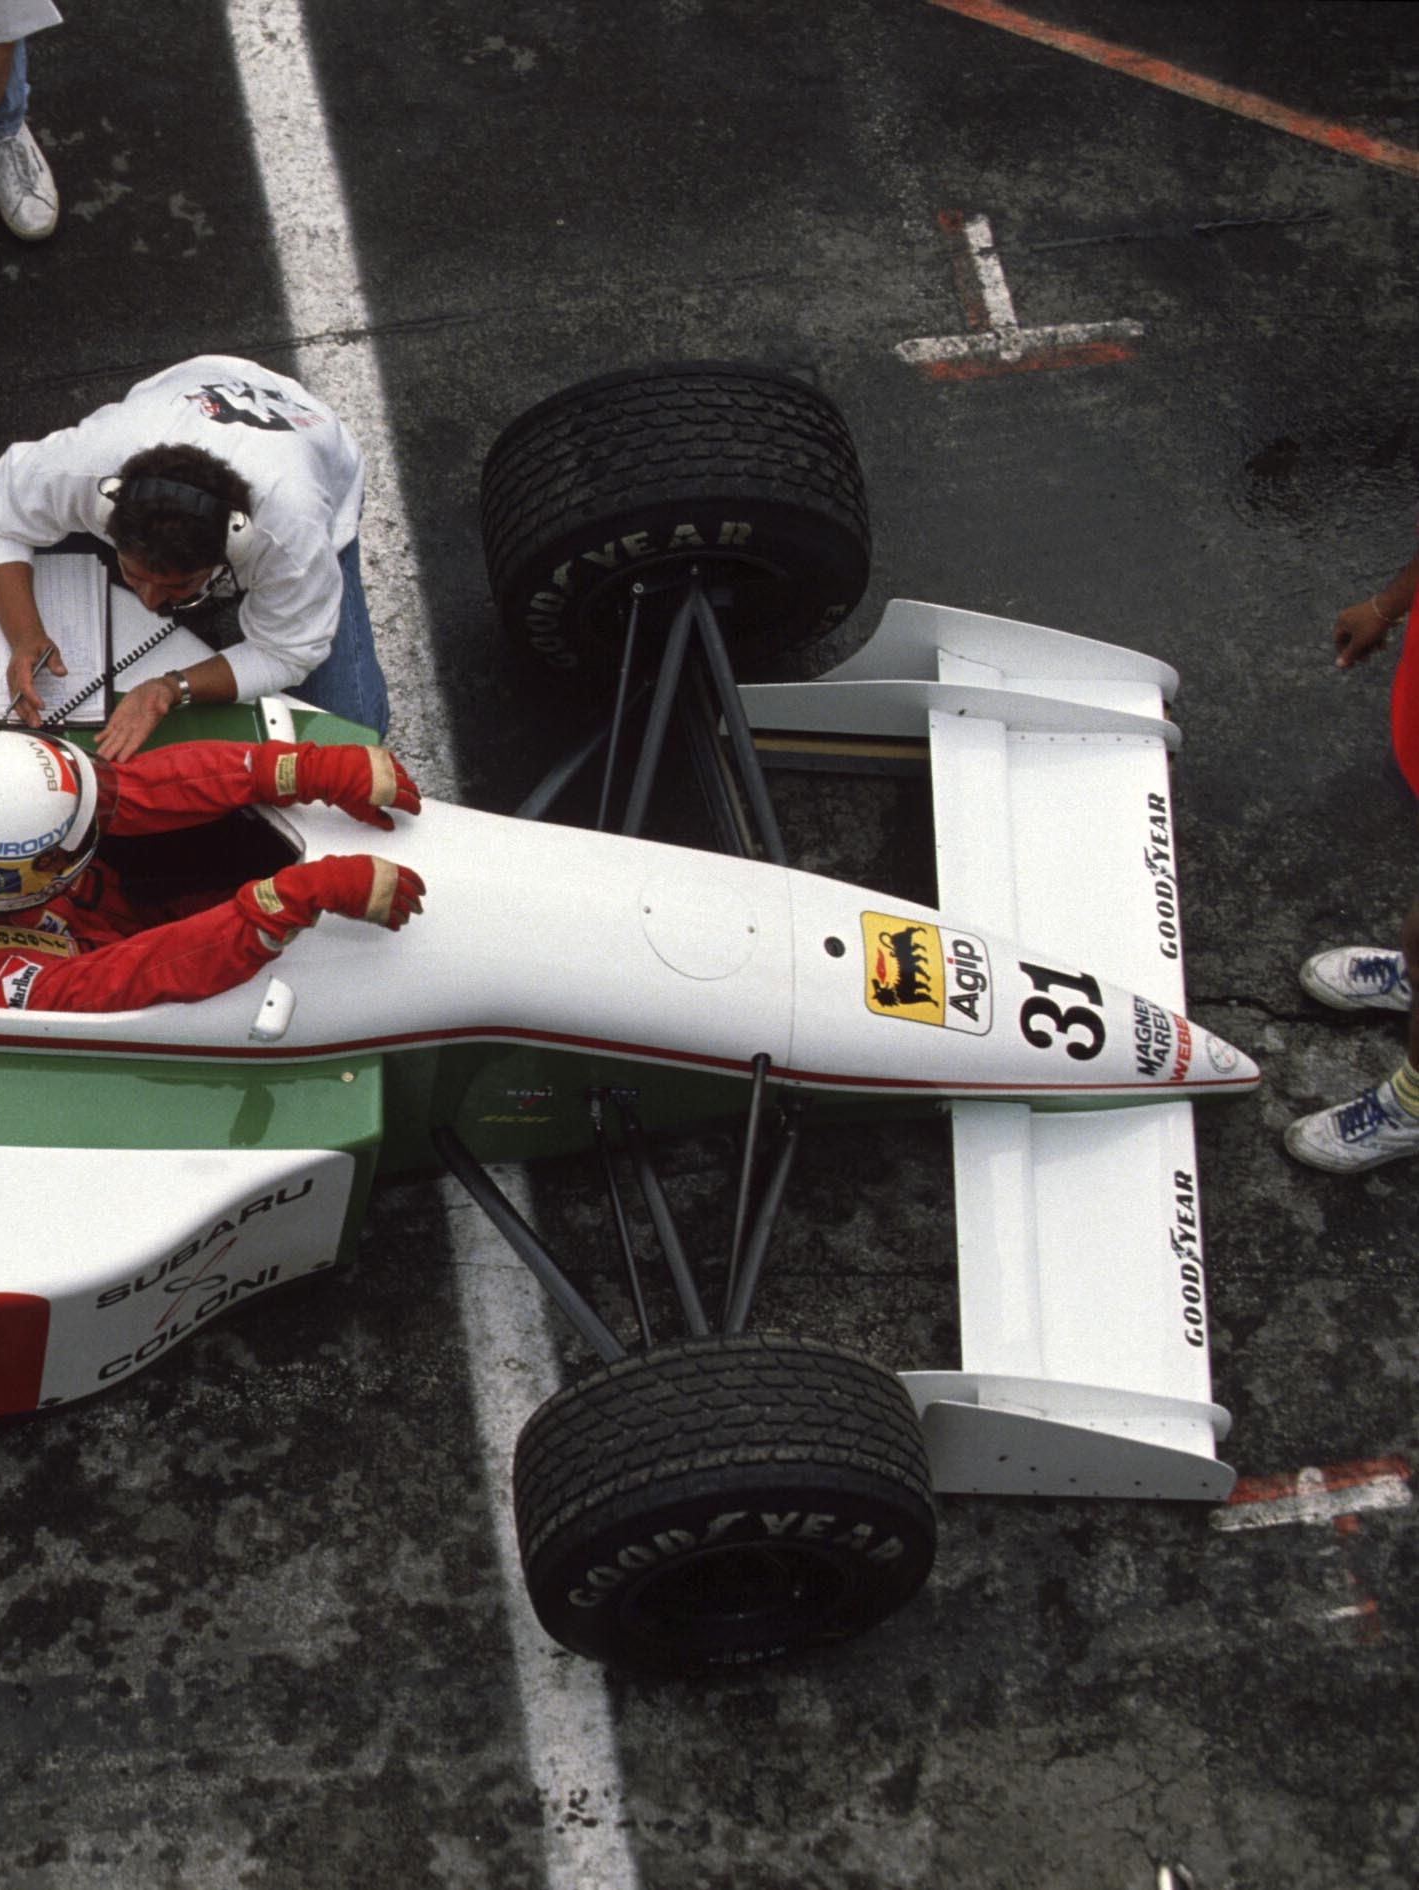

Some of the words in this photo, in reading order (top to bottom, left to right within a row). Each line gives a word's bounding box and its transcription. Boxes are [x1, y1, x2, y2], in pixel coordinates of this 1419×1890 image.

[1143, 791, 1180, 961] GOODYEAR
[9, 965, 39, 1008] Marlboro
[947, 938, 988, 1022] Agip
[1019, 961, 1106, 1061] 31
[1134, 995, 1155, 1077] MAGNET
[1170, 1012, 1192, 1082] WEBE
[95, 1178, 314, 1310] SUBARU
[1169, 1169, 1206, 1348] GOODYEAR
[97, 1264, 279, 1381] COLONI
